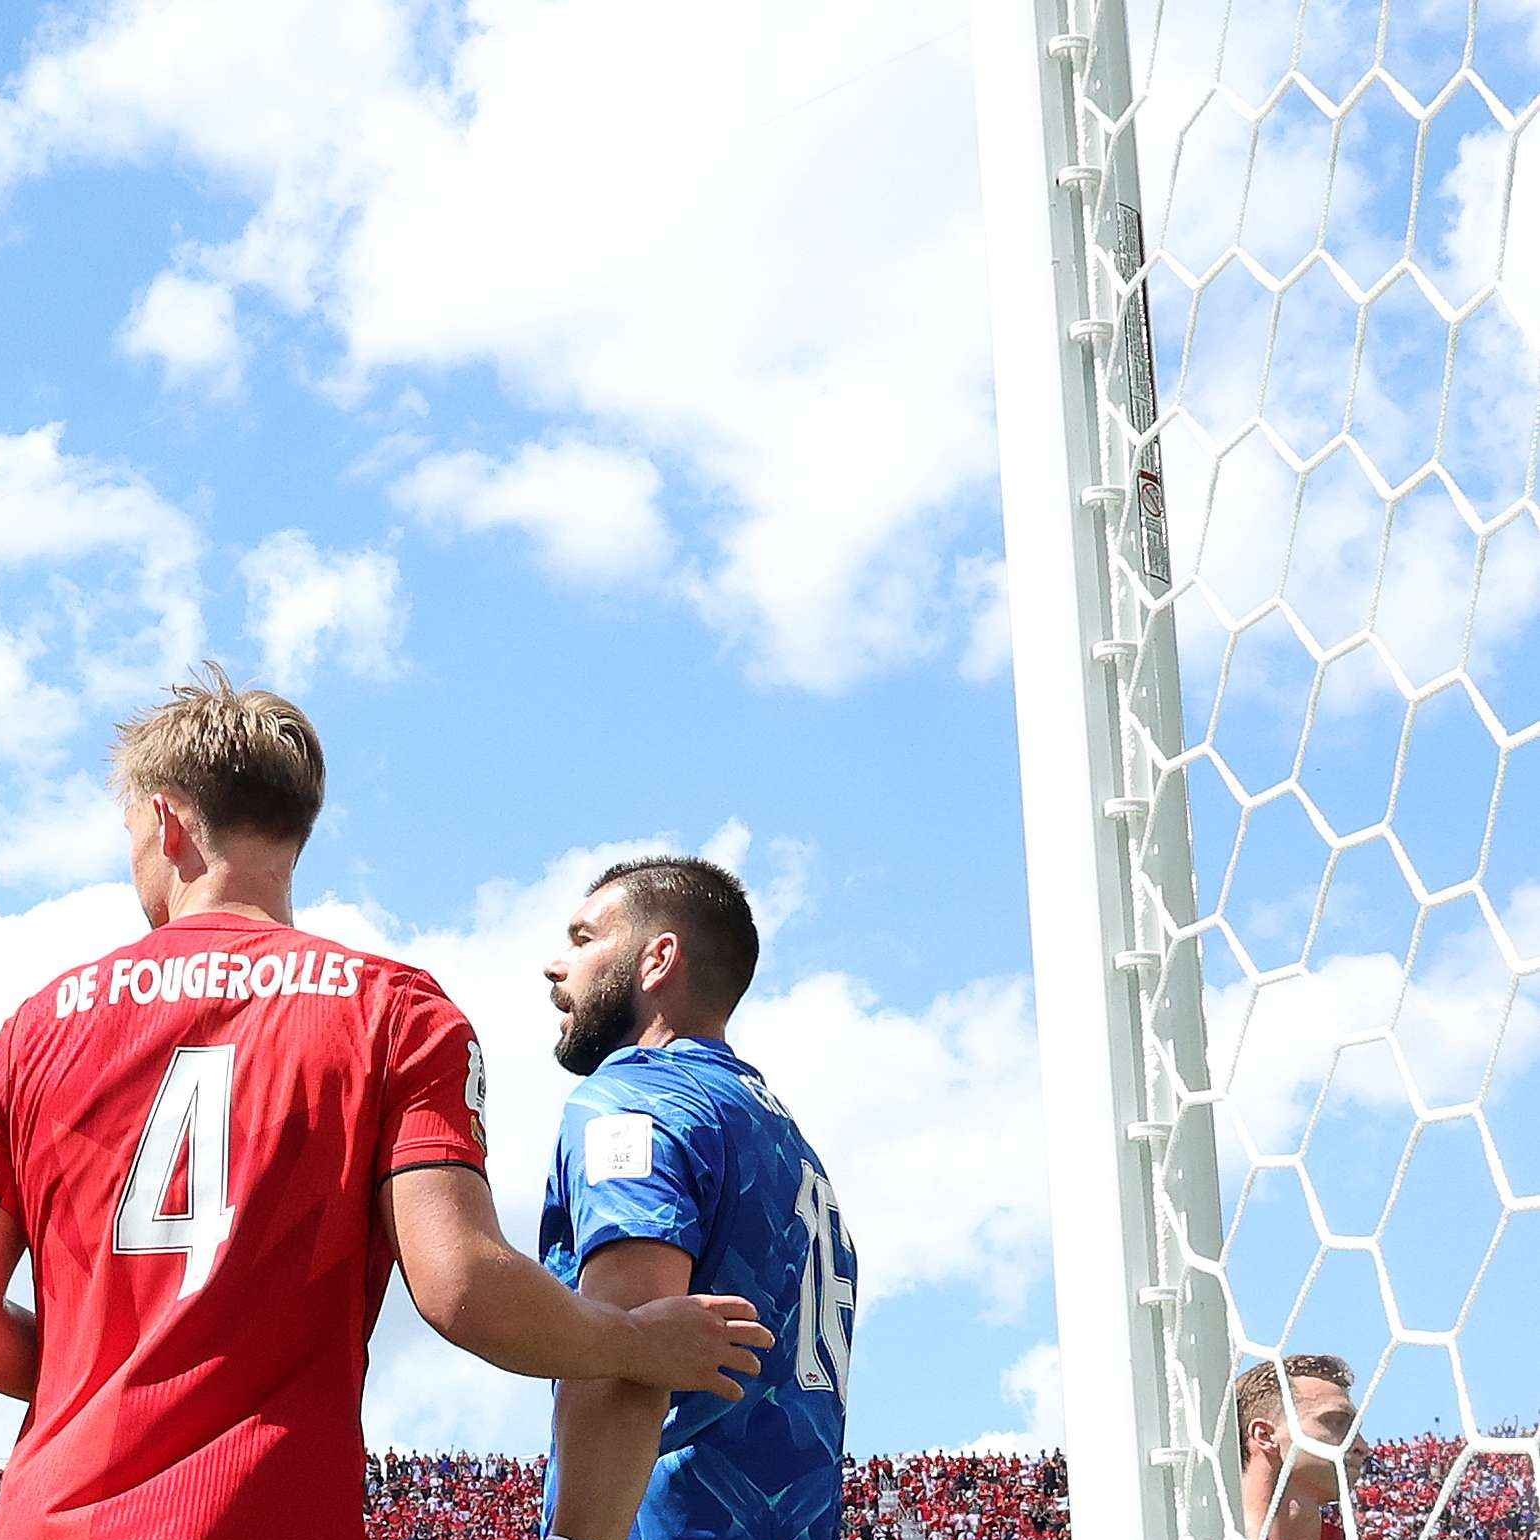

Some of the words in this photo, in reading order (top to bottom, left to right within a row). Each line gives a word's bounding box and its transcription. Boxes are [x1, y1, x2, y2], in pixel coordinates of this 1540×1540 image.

[55, 964, 99, 1019] DE
[108, 950, 364, 1005] FOUGEROLLES
[112, 1043, 236, 1301] 4
